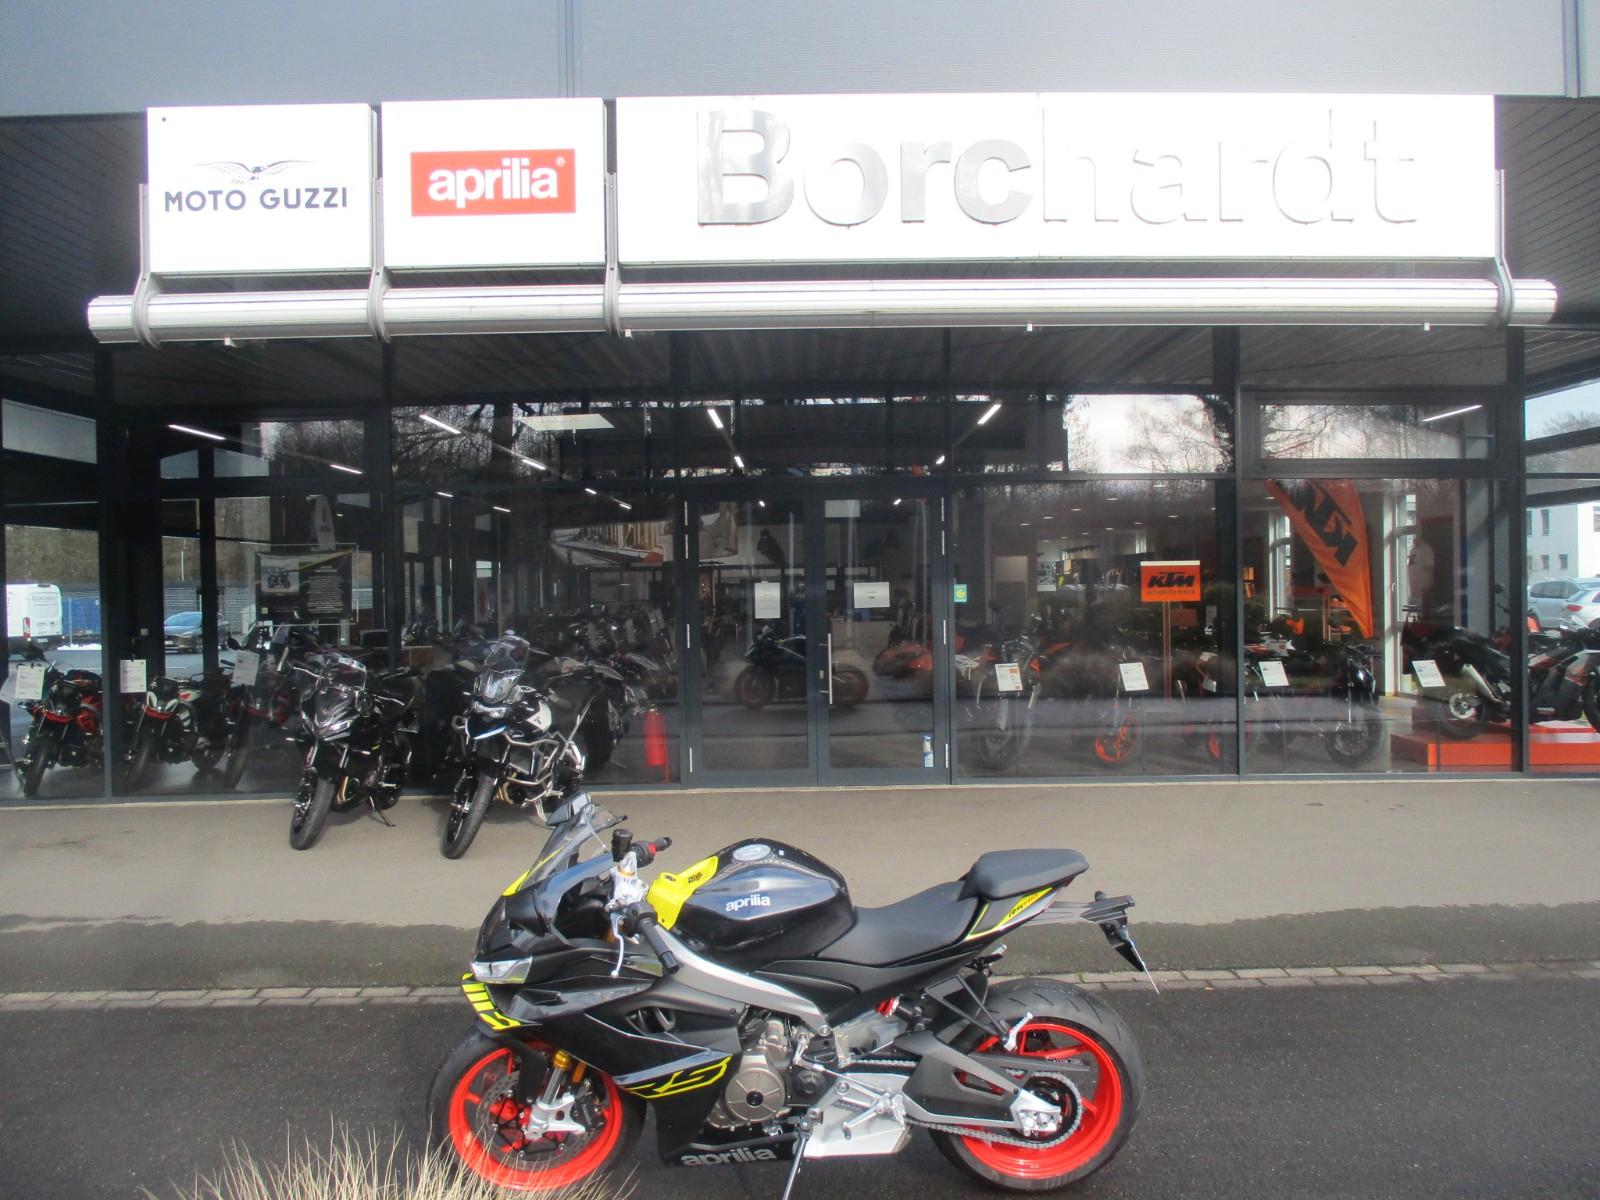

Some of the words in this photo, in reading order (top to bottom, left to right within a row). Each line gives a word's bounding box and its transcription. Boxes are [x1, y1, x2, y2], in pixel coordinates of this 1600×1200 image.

[697, 108, 1416, 226] Borchardt
[427, 156, 559, 209] aprilia
[164, 189, 247, 212] MOTO
[259, 186, 347, 210] GUZZI
[1147, 571, 1196, 588] KTM
[725, 893, 771, 912] aprilia
[680, 1147, 777, 1166] aprilia
